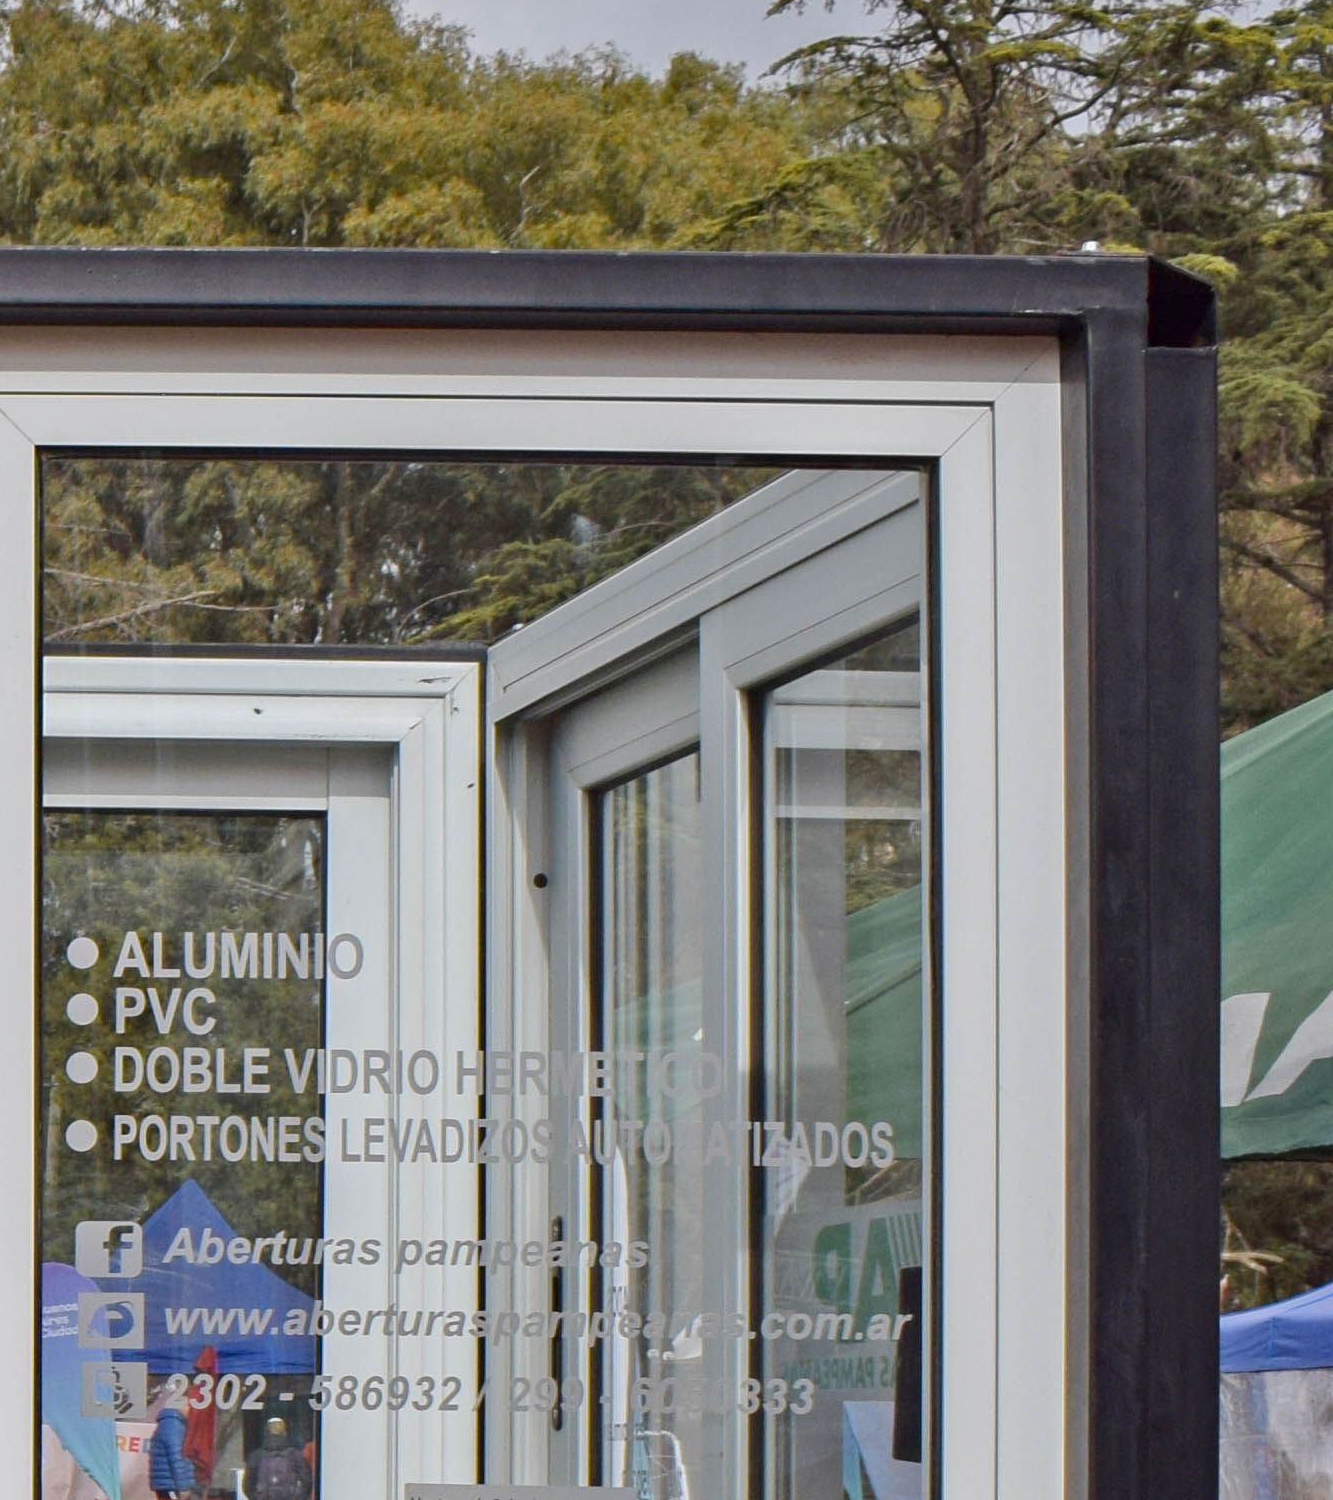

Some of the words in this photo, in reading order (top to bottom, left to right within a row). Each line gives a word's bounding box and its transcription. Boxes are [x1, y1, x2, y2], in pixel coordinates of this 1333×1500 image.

[112, 931, 364, 980] ALUMINIO
[114, 987, 218, 1036] PVC
[113, 1046, 271, 1094] DOBLE
[284, 1047, 440, 1095] VIDRIO
[455, 1050, 721, 1098] HERMETICO
[113, 1114, 326, 1163] PORTONES
[340, 1117, 554, 1164] LEVADIZOS
[162, 1227, 381, 1266] Aberturas
[395, 1236, 651, 1275] pampeanas
[164, 1302, 913, 1348] www.aberturaspampeanas.com.ar
[166, 1373, 267, 1411] 2302
[307, 1374, 462, 1412] 586932
[510, 1376, 585, 1413] 299
